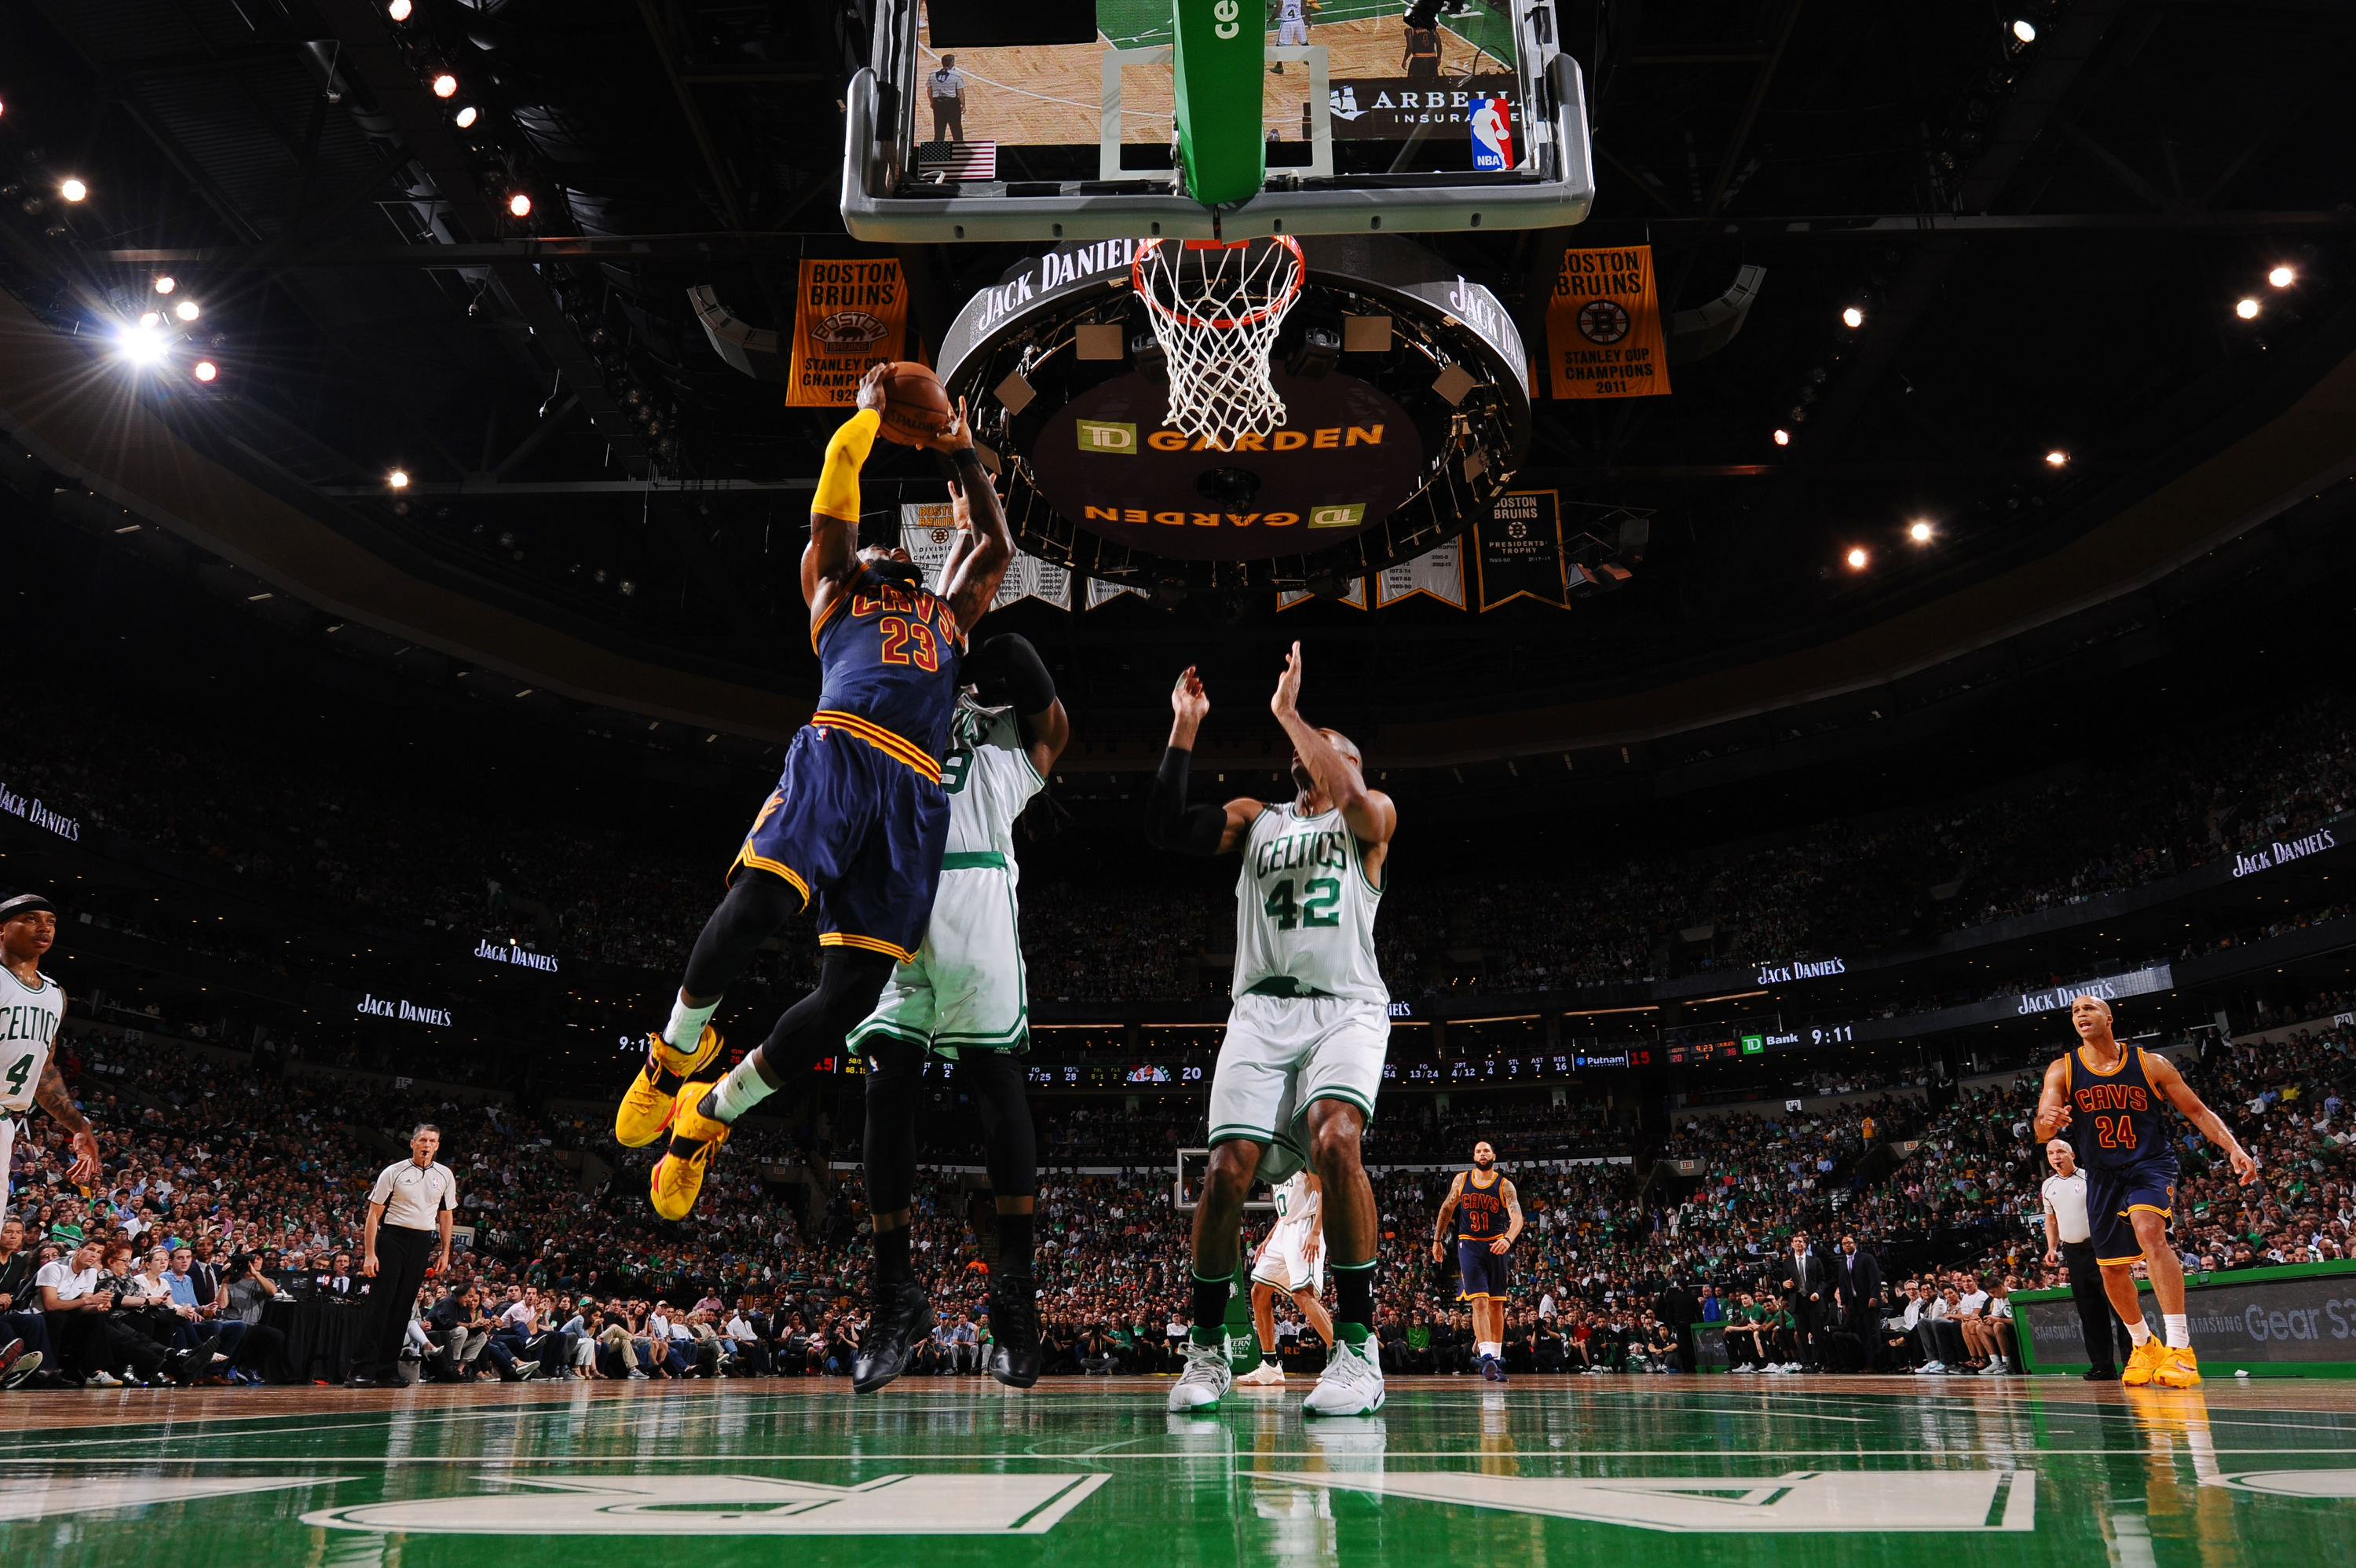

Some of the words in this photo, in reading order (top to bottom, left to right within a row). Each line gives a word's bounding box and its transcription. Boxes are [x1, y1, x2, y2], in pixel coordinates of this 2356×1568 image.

[1287, 9, 1296, 19] 4
[1477, 155, 1500, 166] NBA
[813, 264, 897, 283] BOSTON
[1557, 272, 1642, 296] BRUINS
[810, 283, 894, 305] BRUINS
[979, 270, 1034, 331] JACK
[1449, 274, 1500, 342] JACK
[814, 312, 887, 340] BOSTON
[829, 342, 868, 352] BRUINS
[1565, 350, 1624, 365] STANLEY
[1626, 348, 1650, 363] CUP
[805, 358, 862, 371] STANLEY
[1566, 364, 1654, 380] CHAMPIONS
[803, 373, 865, 386] CHAMPI
[1597, 381, 1626, 393] 2011
[1082, 425, 1131, 448] TD
[1147, 424, 1385, 451] GARDEN
[919, 506, 953, 517] BOSTO
[1085, 505, 1301, 527] GARDEN
[1314, 507, 1359, 525] TD
[1494, 507, 1538, 519] BRUINS
[918, 517, 955, 528] BRUIN
[852, 584, 956, 645] CAVS
[880, 616, 938, 672] 23
[29, 798, 81, 842] DANIEL'S
[1256, 831, 1348, 880] CELTICS
[2233, 850, 2273, 878] JACK
[2272, 828, 2336, 864] DANIEL'S
[1264, 877, 1341, 933] 42
[474, 939, 507, 963] JACK
[511, 945, 558, 972] DANIEL'S
[1757, 966, 1792, 985] JACK
[1794, 956, 1846, 980] DANIEL'S
[357, 993, 396, 1018] JACK
[399, 1000, 452, 1027] DANIEL'S
[2018, 993, 2057, 1014] JACK
[1743, 1038, 1761, 1051] TD
[1766, 1033, 1798, 1046] Bank
[1812, 1025, 1853, 1045] 9:11
[1587, 1055, 1625, 1065] Putnam
[1630, 1051, 1650, 1065] 15
[6, 1054, 35, 1095] 4
[1182, 1066, 1202, 1080] 20
[1384, 1070, 1396, 1079] 54
[1410, 1070, 1440, 1079] 13/24
[1451, 1069, 1476, 1077] 4/12
[1487, 1067, 1494, 1076] 4
[1535, 1064, 1541, 1073] 7
[1556, 1062, 1568, 1071] 16
[2075, 1084, 2148, 1113] CAVS
[2095, 1116, 2136, 1149] 24
[1277, 1193, 1288, 1218] 0
[1462, 1193, 1500, 1214] CAVS
[1469, 1211, 1489, 1232] 31
[2035, 1325, 2077, 1341] SAMSUNG
[2245, 1304, 2320, 1342] Gear
